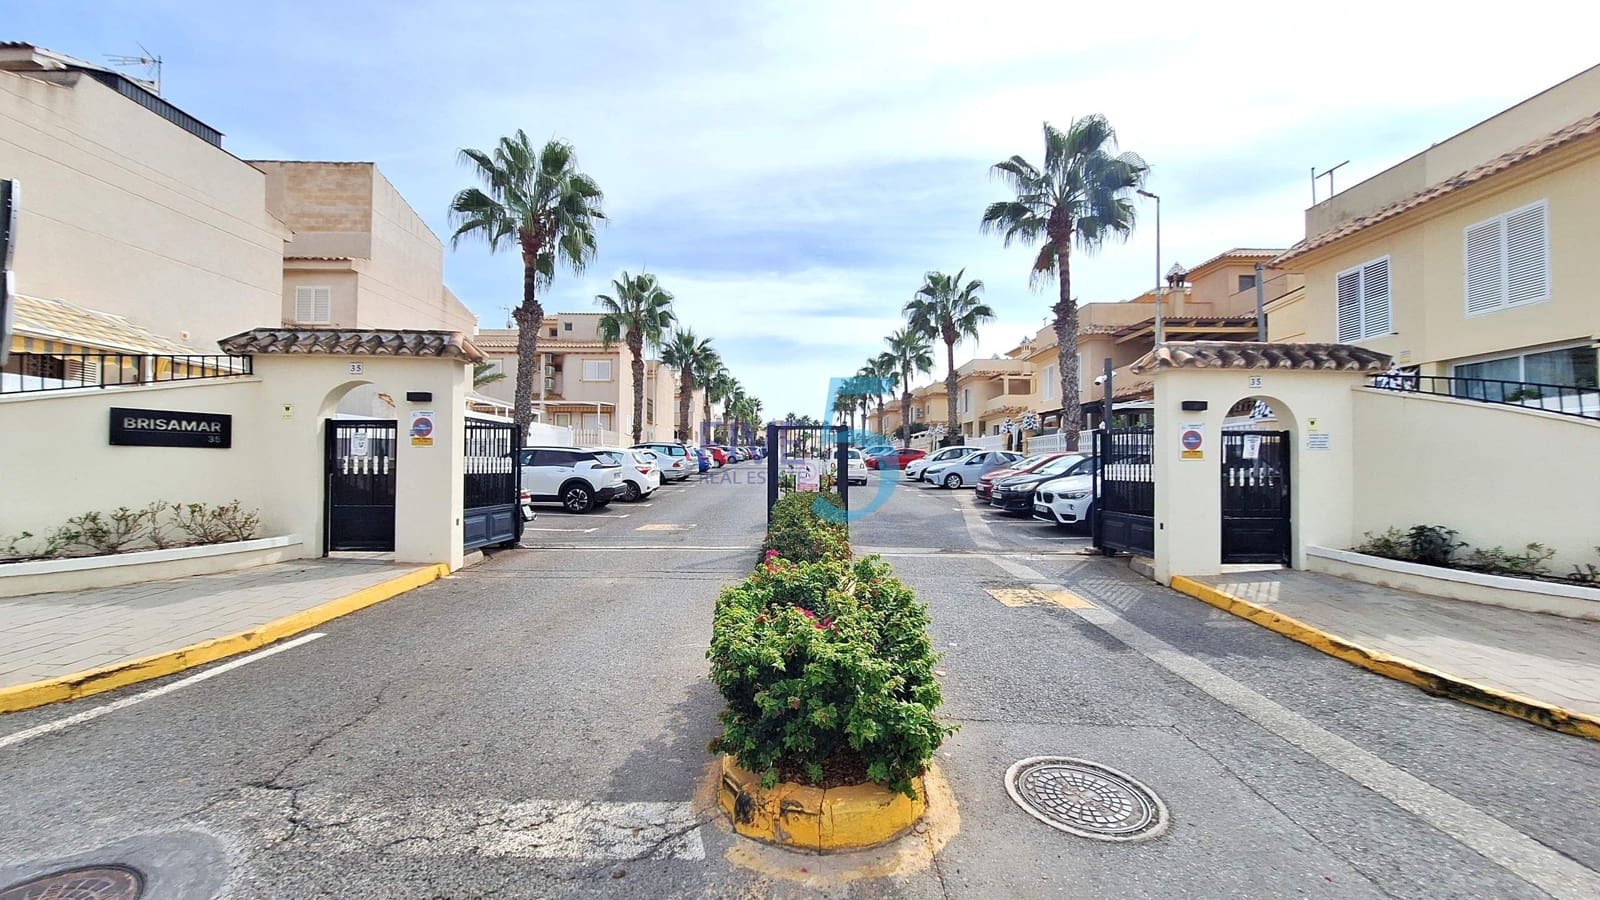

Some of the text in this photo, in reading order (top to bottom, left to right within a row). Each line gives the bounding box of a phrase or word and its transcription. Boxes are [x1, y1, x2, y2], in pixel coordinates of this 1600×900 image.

[350, 364, 361, 372] 35
[1250, 378, 1261, 386] 35
[123, 417, 221, 432] BRISAMAR
[207, 435, 221, 443] 35
